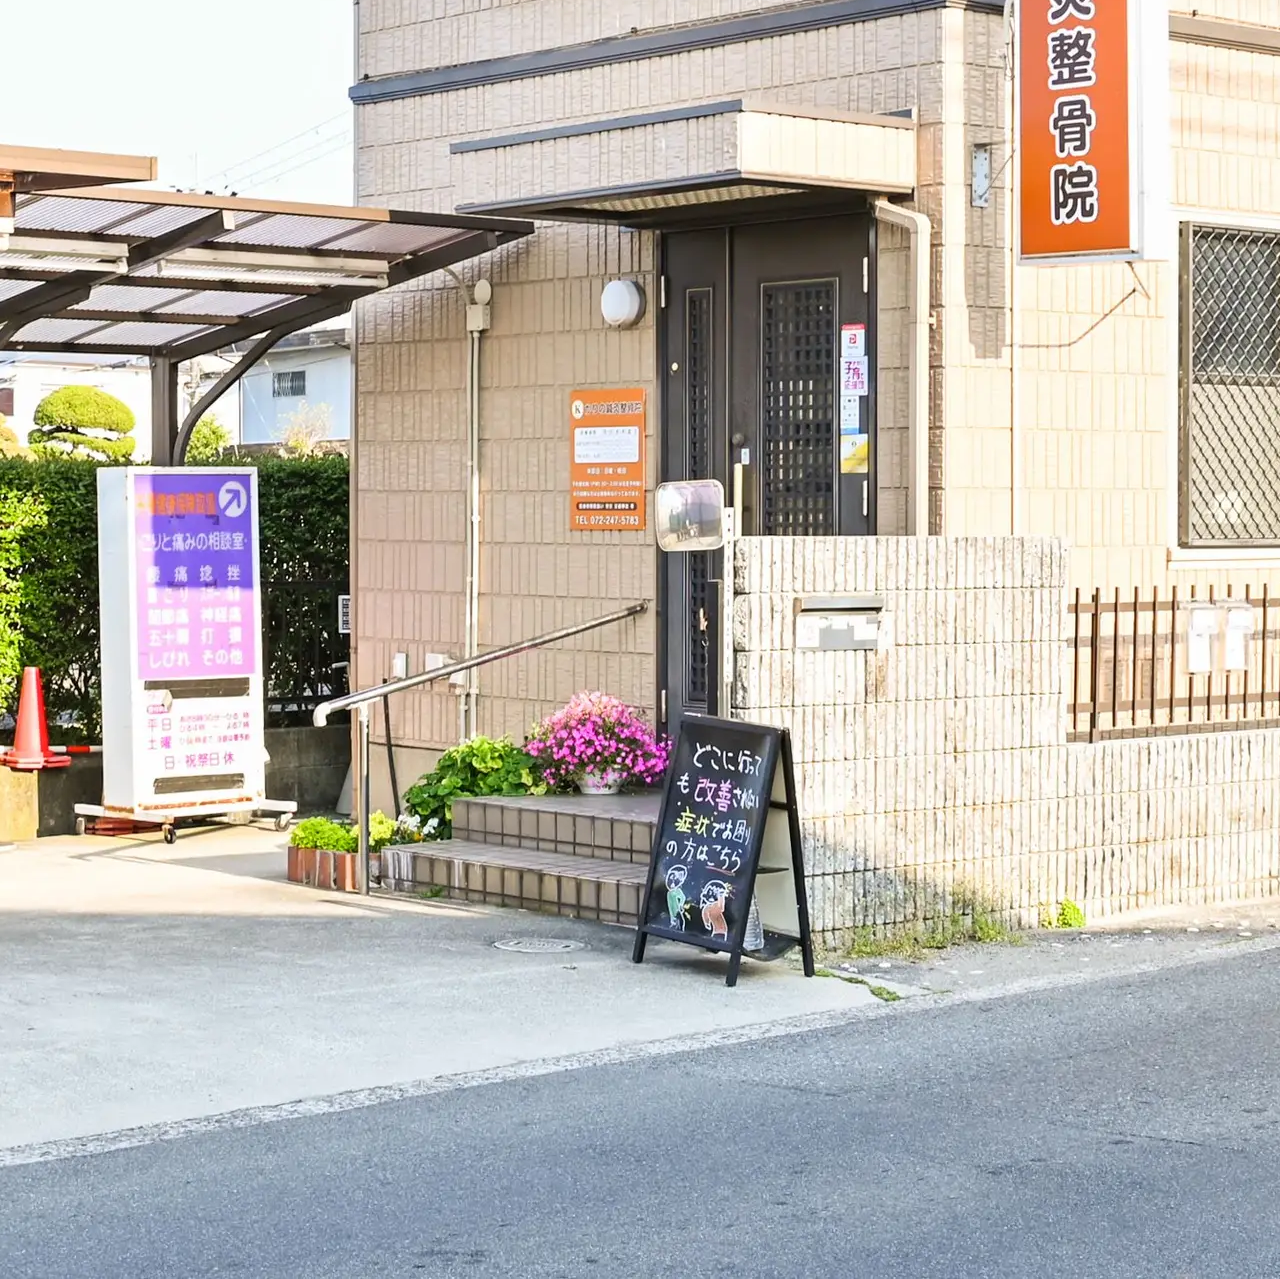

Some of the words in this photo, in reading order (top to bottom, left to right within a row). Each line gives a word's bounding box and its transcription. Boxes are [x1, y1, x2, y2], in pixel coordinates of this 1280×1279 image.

[576, 515, 589, 525] TEL
[202, 648, 243, 666] その他
[693, 742, 762, 777] どこに行って
[666, 837, 743, 873] の方はこちら
